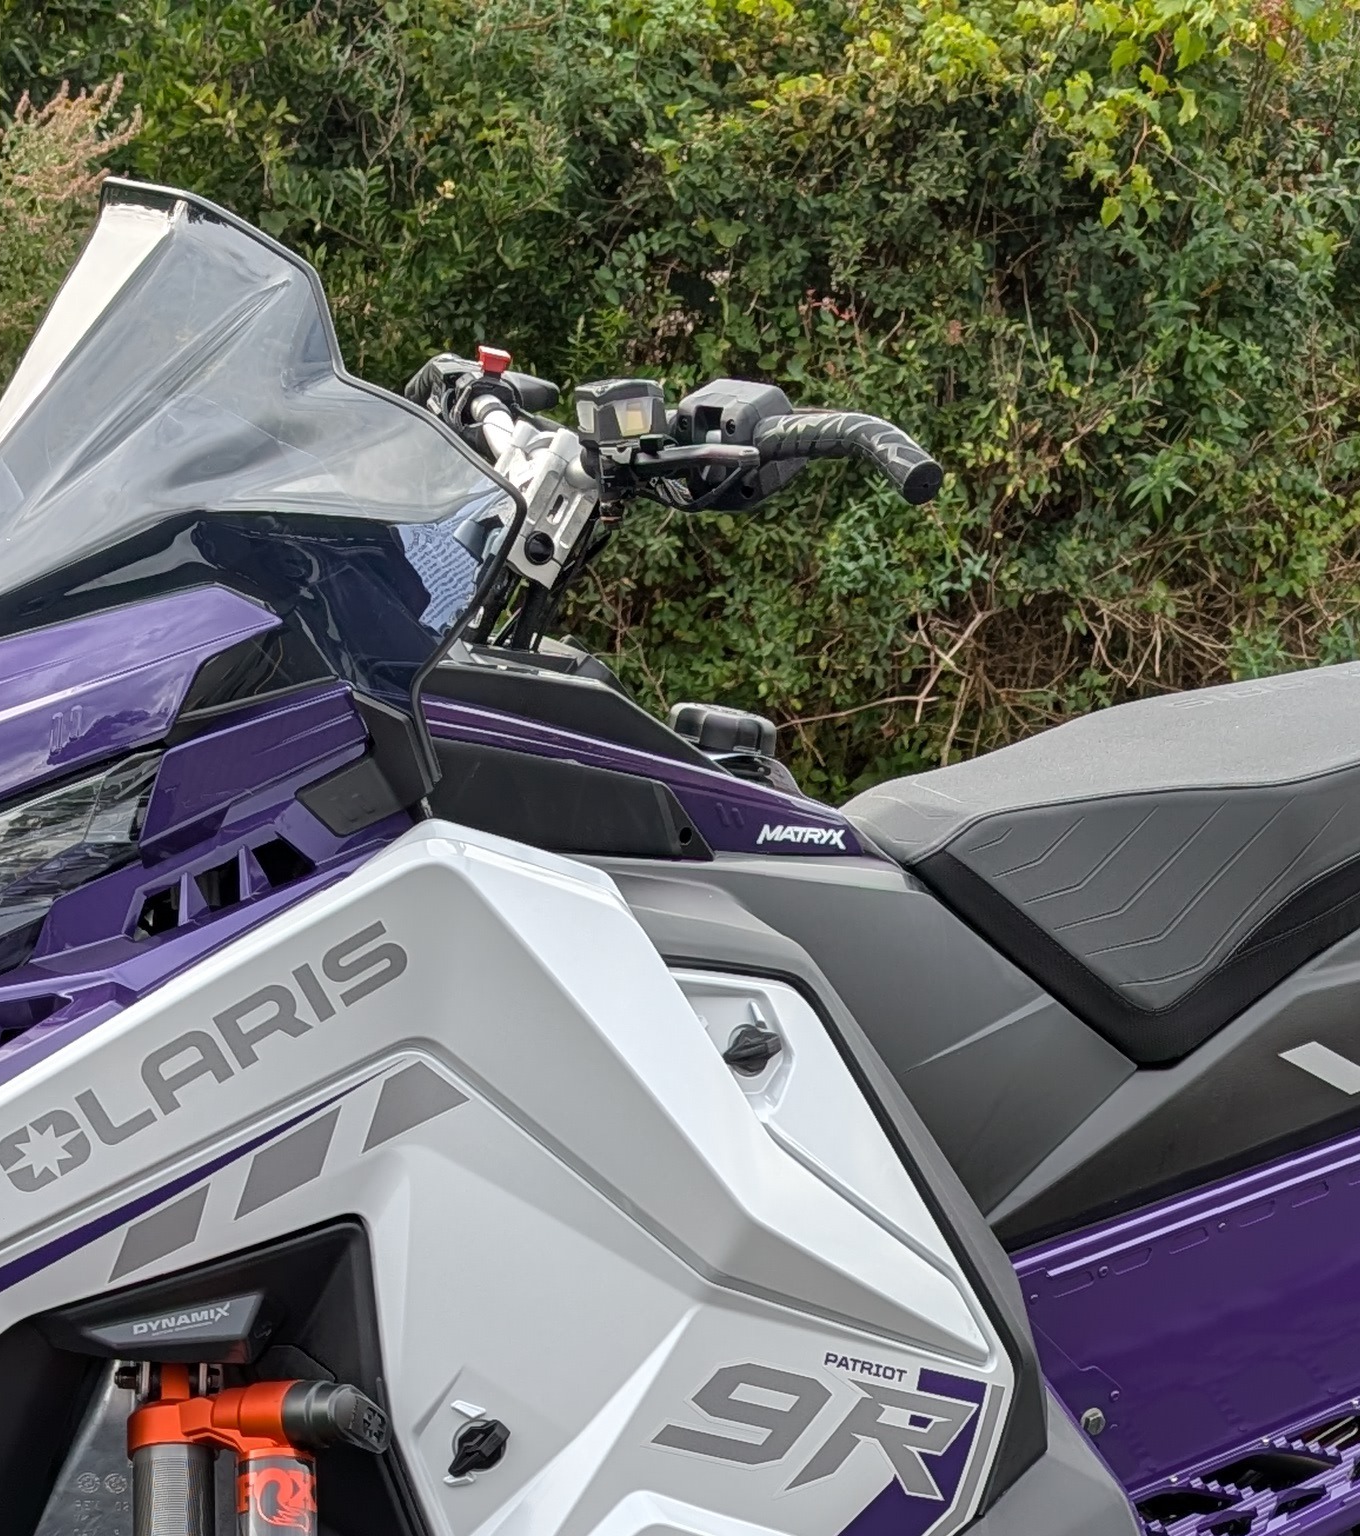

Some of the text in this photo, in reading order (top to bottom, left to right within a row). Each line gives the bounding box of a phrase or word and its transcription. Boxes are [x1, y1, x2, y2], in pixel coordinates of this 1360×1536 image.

[756, 824, 846, 850] MATRYX
[133, 1302, 231, 1335] DYNAMIX
[824, 1352, 908, 1382] PATRIOT
[649, 1362, 979, 1501] 9R
